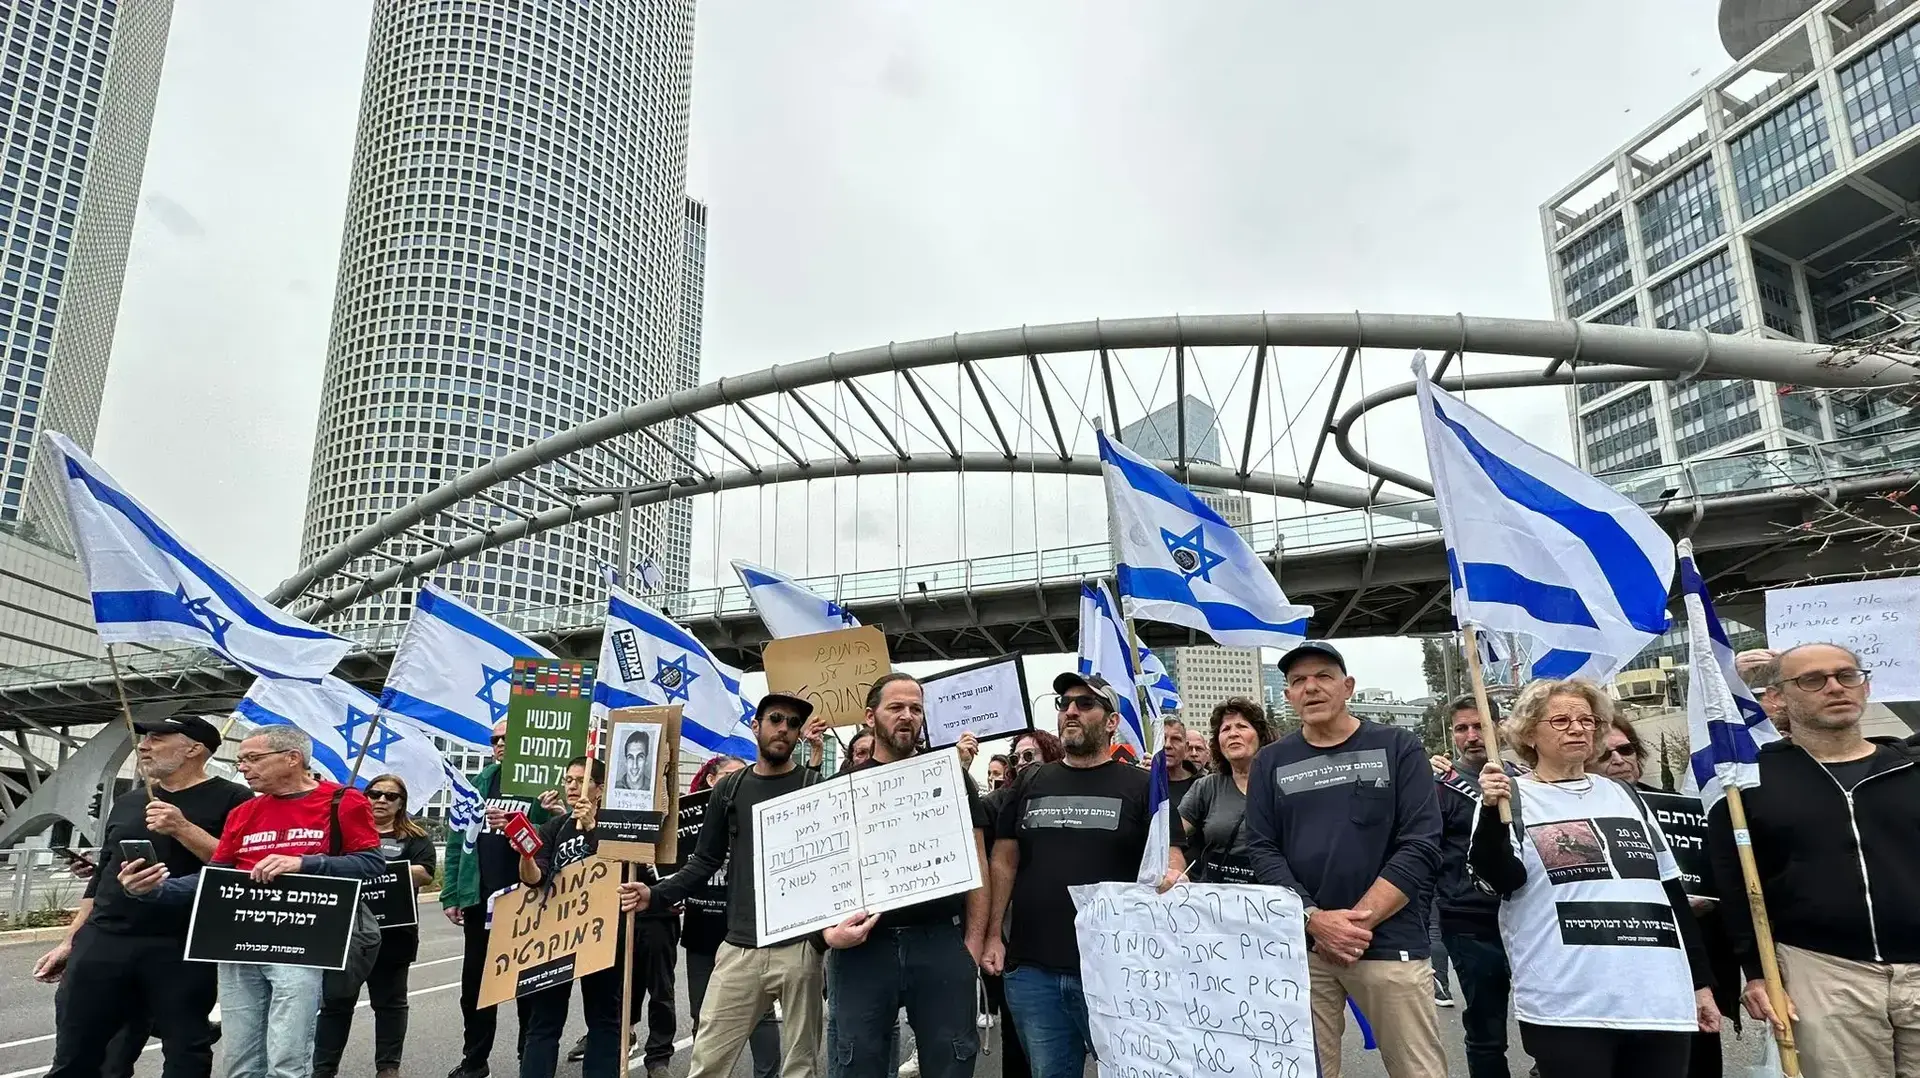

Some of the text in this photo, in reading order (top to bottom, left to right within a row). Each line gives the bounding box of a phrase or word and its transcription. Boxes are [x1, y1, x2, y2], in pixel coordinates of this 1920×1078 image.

[1882, 612, 1899, 622] 55
[526, 709, 572, 731] ועכשיו
[520, 736, 571, 759] נלחמים
[1320, 765, 1333, 775] לנו
[1354, 761, 1384, 770] במותם
[512, 763, 549, 786] הבית
[869, 802, 887, 814] את
[912, 805, 949, 822] ישראל
[1091, 808, 1116, 818] במותם
[865, 817, 901, 834] יהודית
[1657, 809, 1709, 827] מותם
[286, 828, 324, 840] מאבק
[1616, 828, 1630, 838] 20
[909, 838, 939, 854] האם
[220, 883, 339, 906] במותם ציוו לנו
[556, 890, 589, 922] ציוו
[1236, 894, 1286, 925] אחי
[234, 909, 317, 926] דמוקרטיה
[1565, 918, 1621, 930] דמוקרטיה
[1623, 917, 1640, 929] לנו
[234, 942, 305, 954] משפחות שכולות
[495, 917, 605, 977] דמוקרטיה
[1181, 941, 1228, 964] אתה
[1239, 933, 1292, 960] האם
[1188, 972, 1236, 995] אתה
[1249, 975, 1299, 1001] האם
